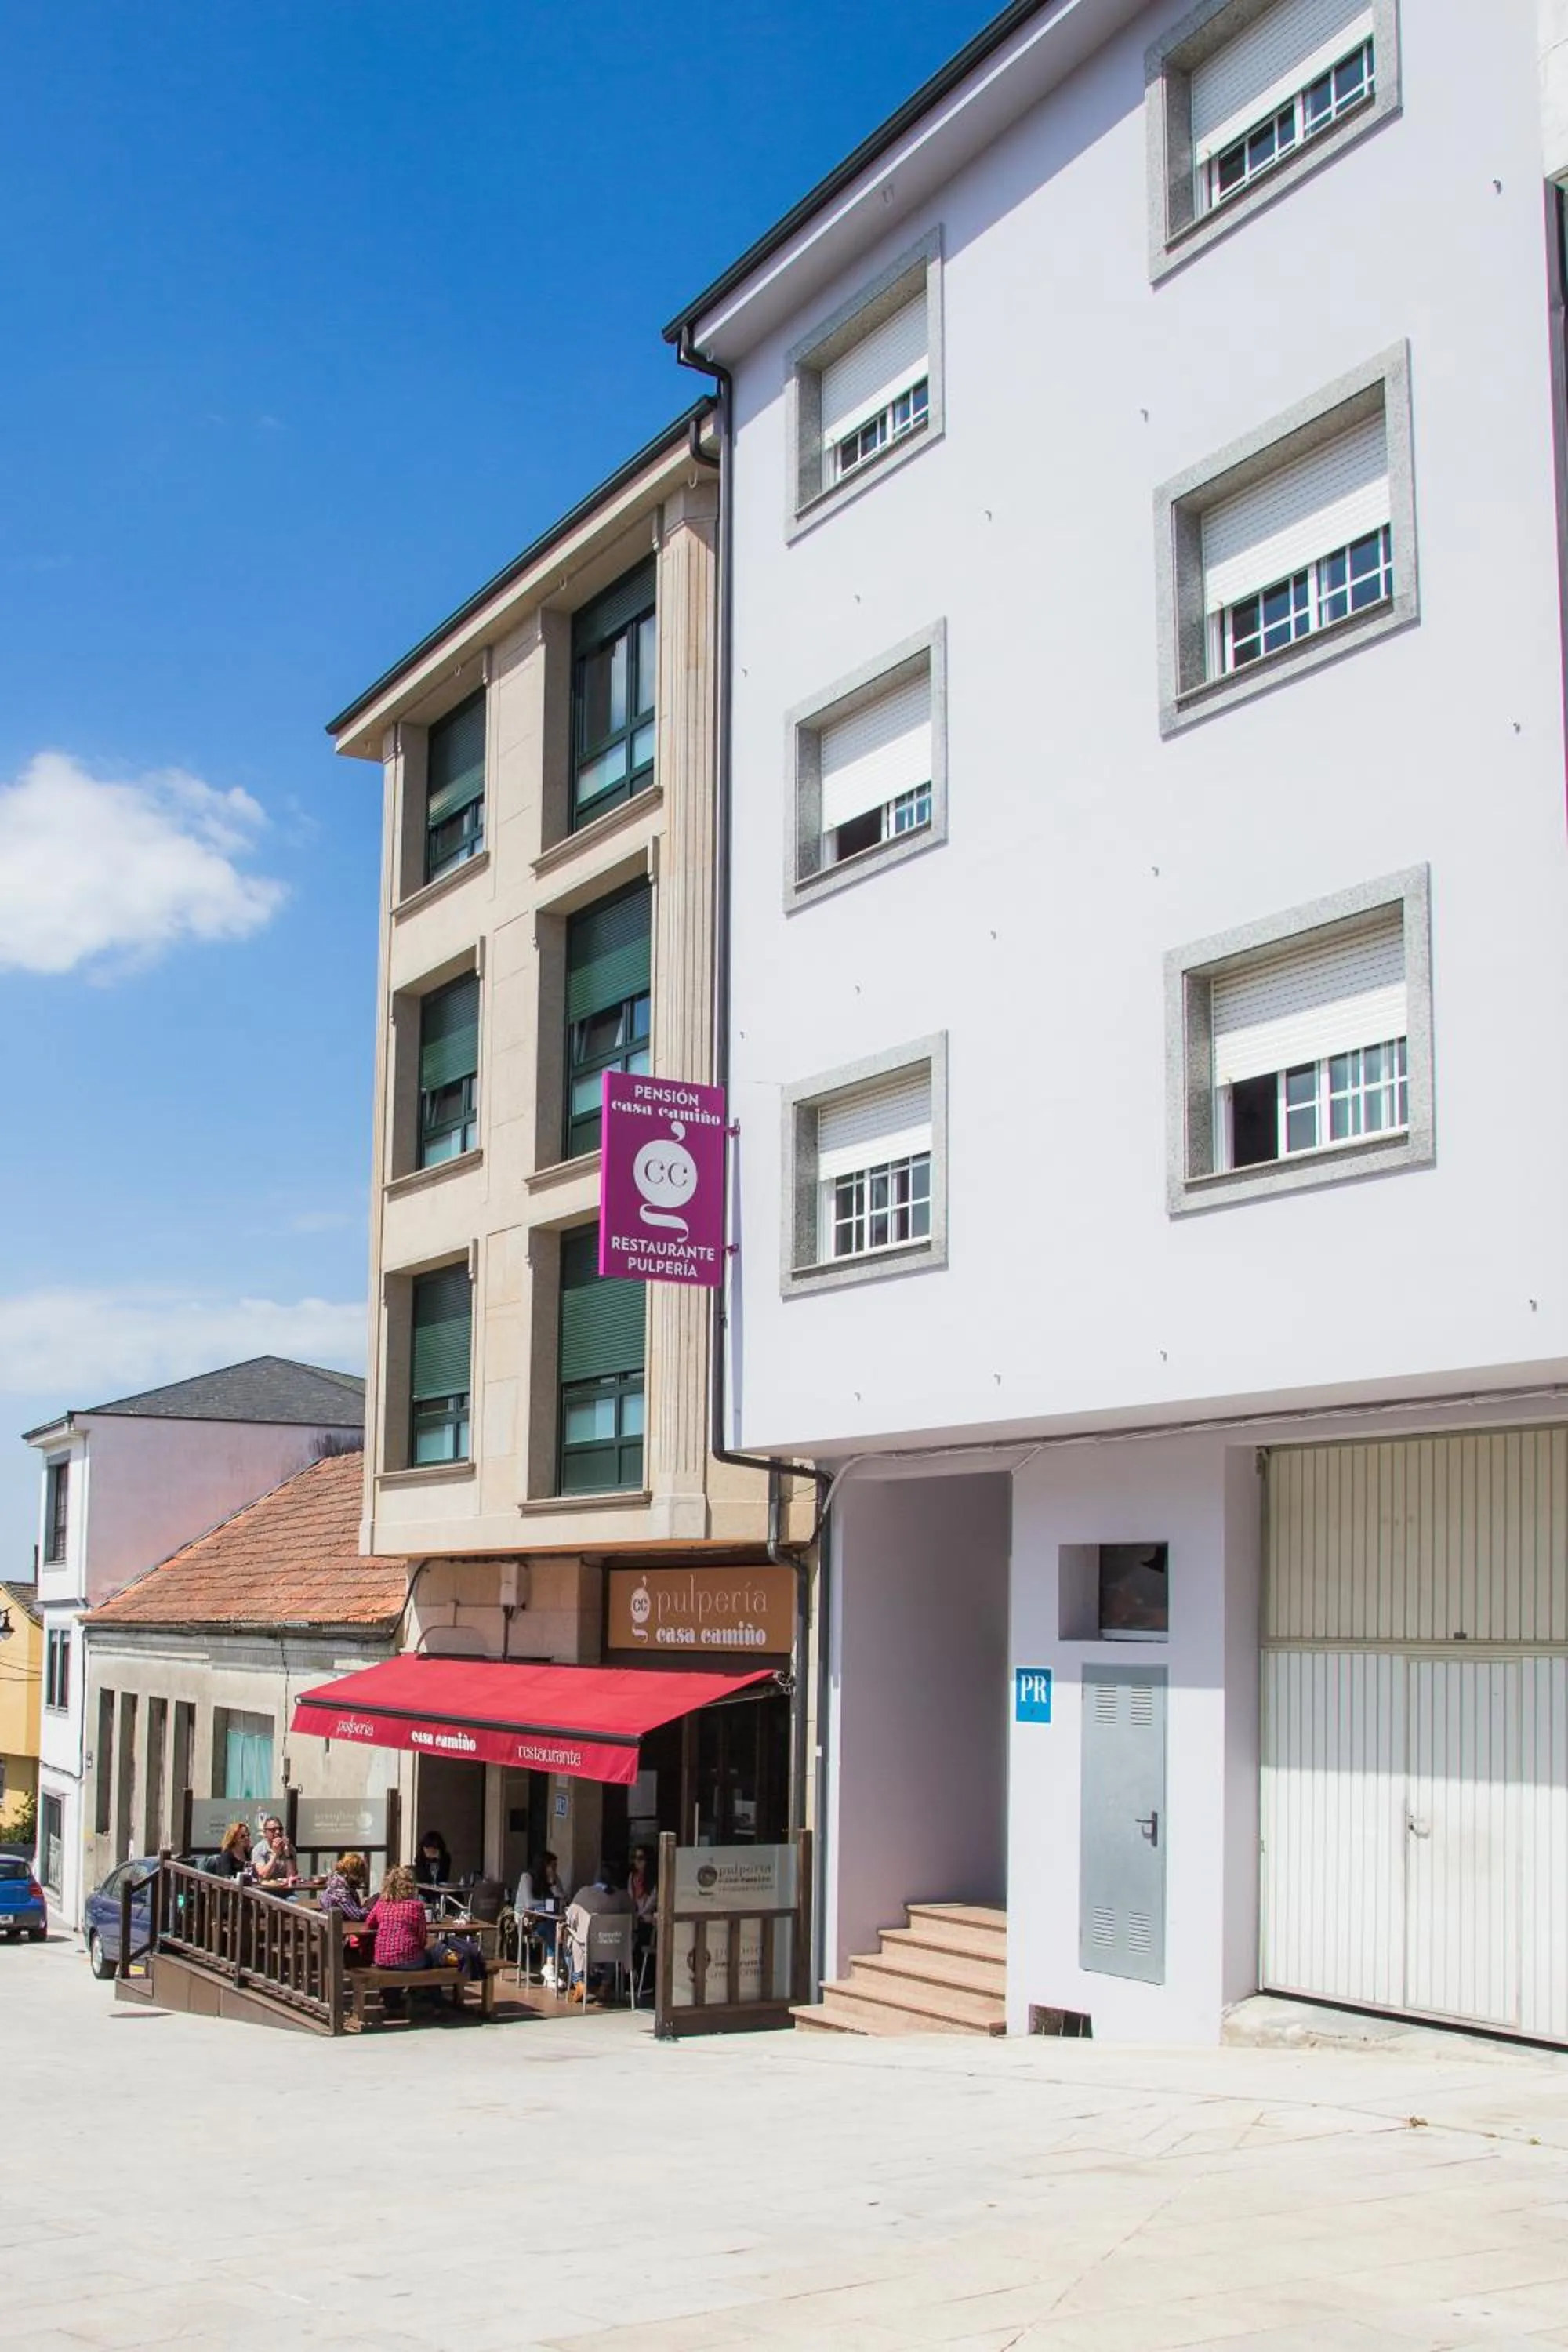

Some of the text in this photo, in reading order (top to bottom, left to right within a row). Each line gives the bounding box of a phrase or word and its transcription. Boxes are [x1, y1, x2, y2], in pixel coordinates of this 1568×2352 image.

[634, 1084, 699, 1106] PENSIÓN
[611, 1100, 652, 1116] casa
[612, 1236, 715, 1261] RESTAURANTE
[628, 1256, 698, 1277] PULPERÍA
[656, 1574, 767, 1623] pulpería
[656, 1626, 696, 1644] casa
[1019, 1674, 1047, 1704] PR
[412, 1730, 434, 1745] casa
[518, 1744, 582, 1766] restaurante
